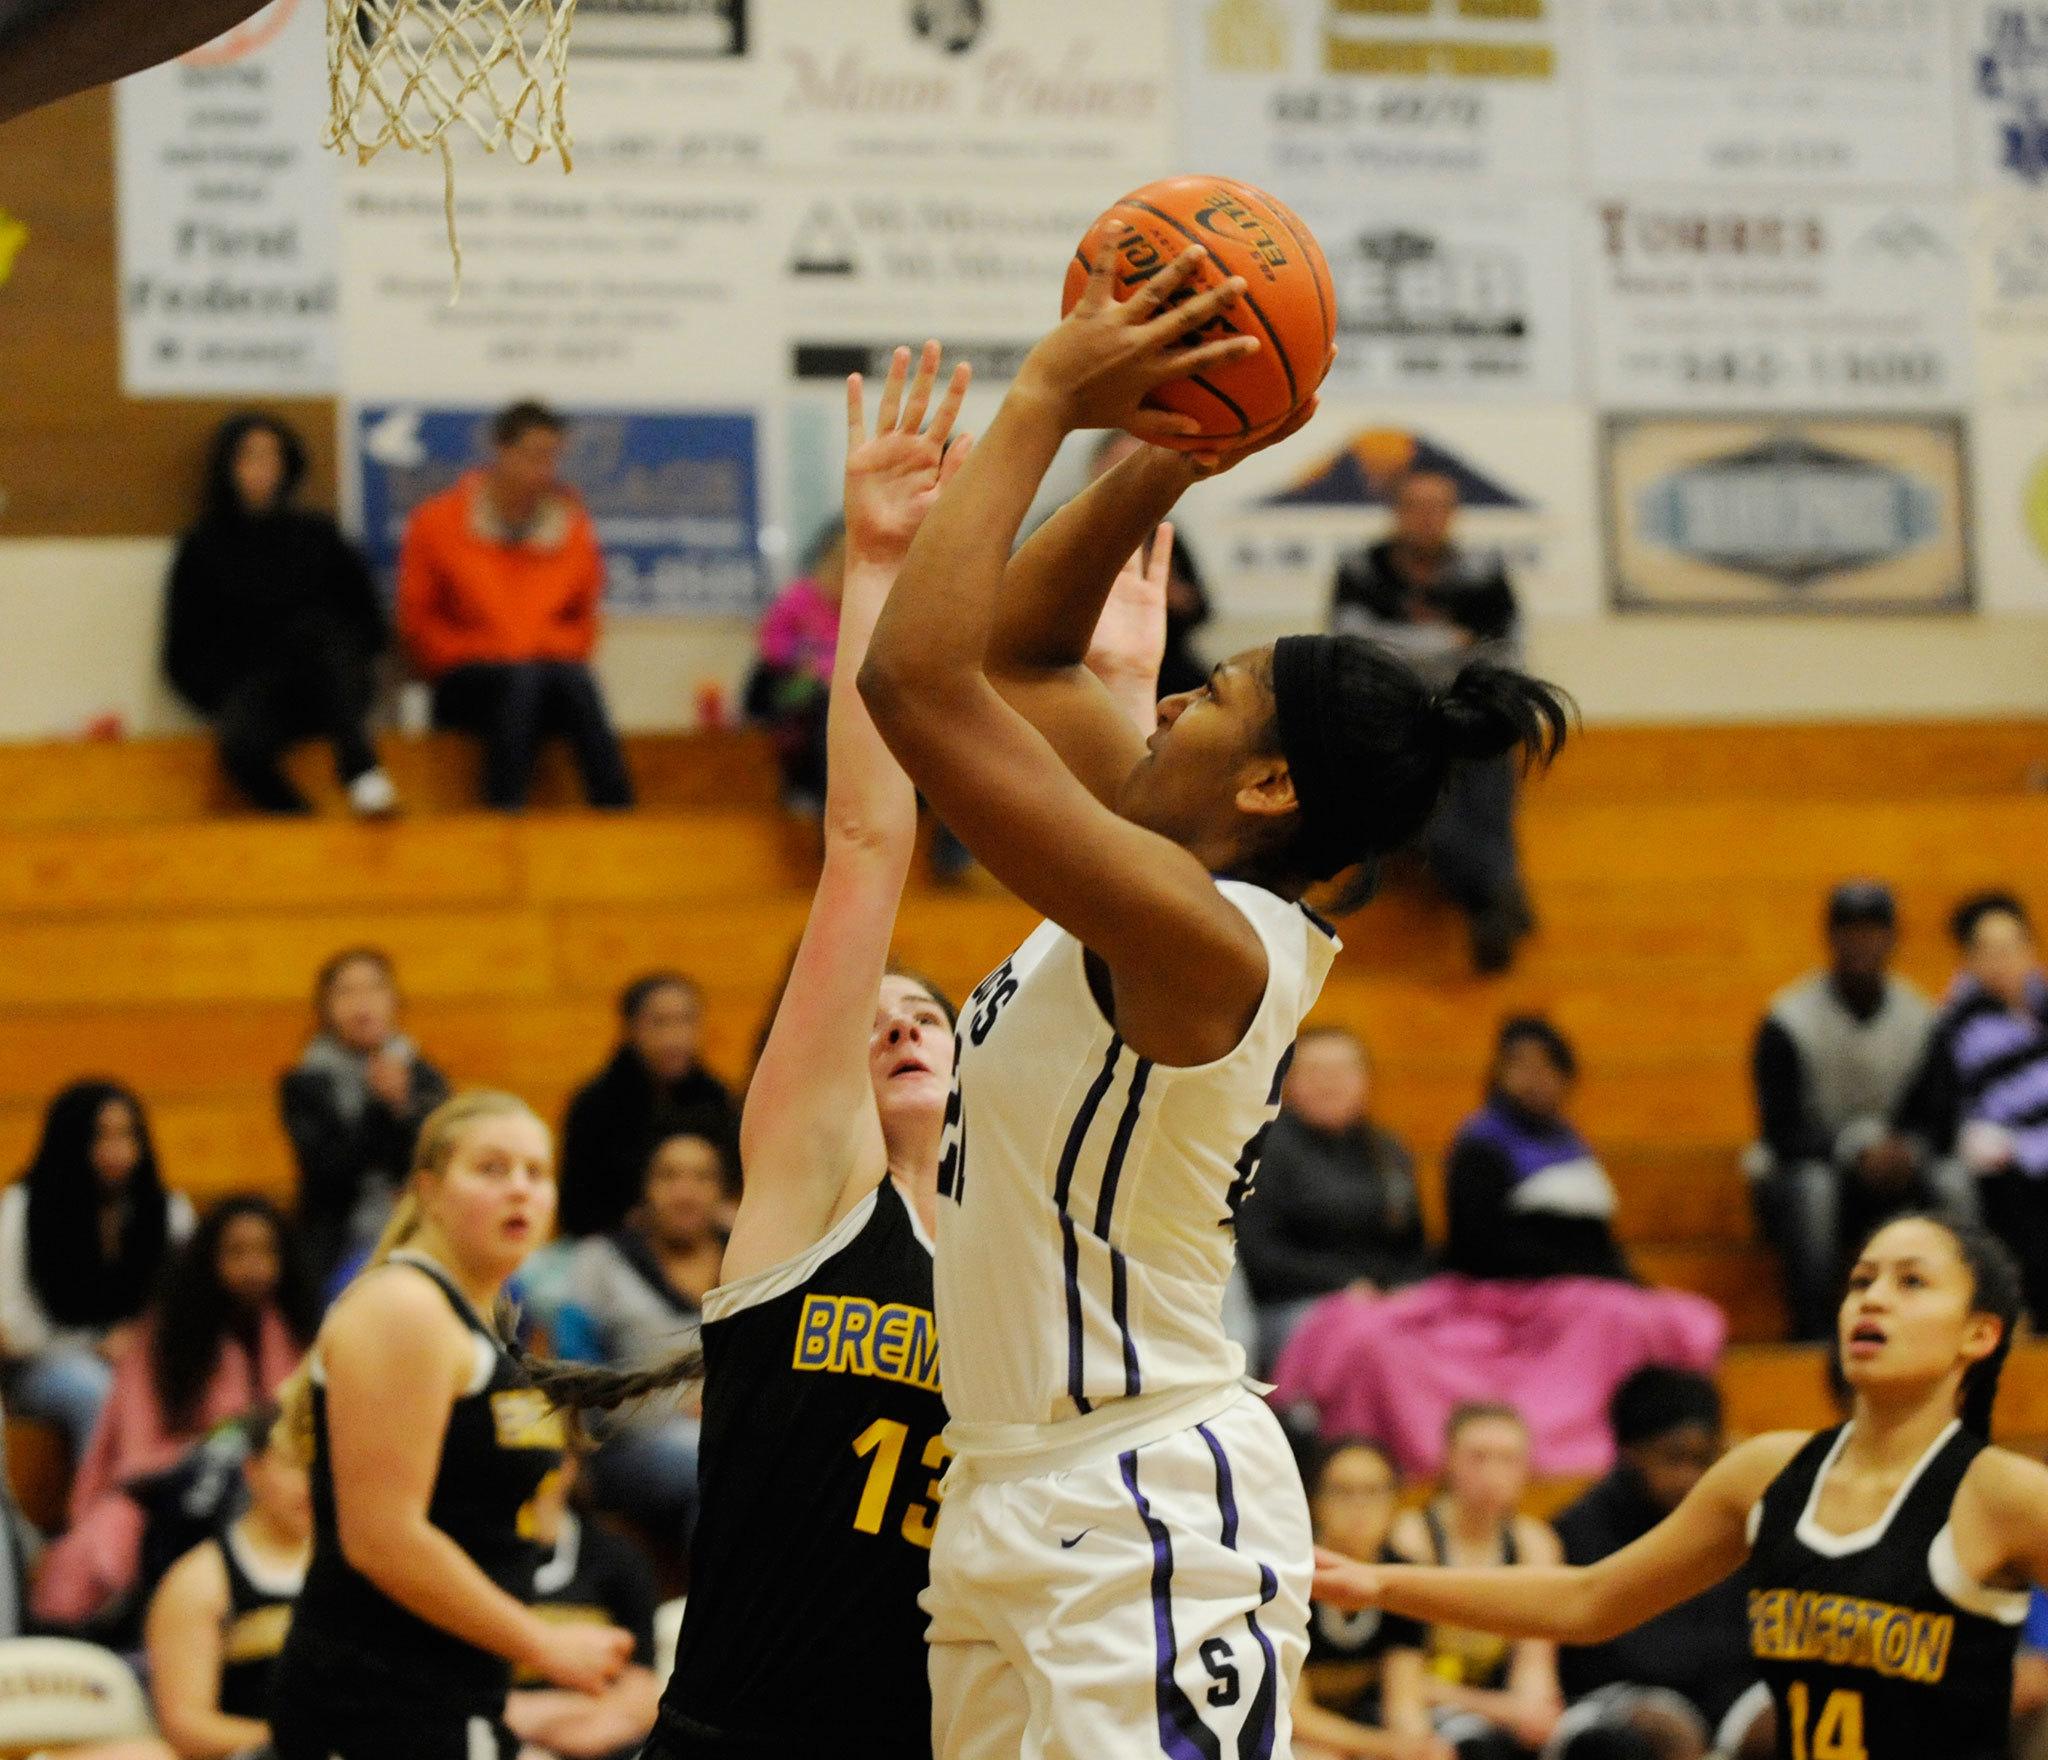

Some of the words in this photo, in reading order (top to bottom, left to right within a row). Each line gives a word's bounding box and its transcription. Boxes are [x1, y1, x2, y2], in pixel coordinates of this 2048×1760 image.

[1204, 194, 1287, 267] ELITE
[852, 1417, 958, 1550] 13
[1199, 1637, 1241, 1708] S
[1787, 1680, 1869, 1760] 14
